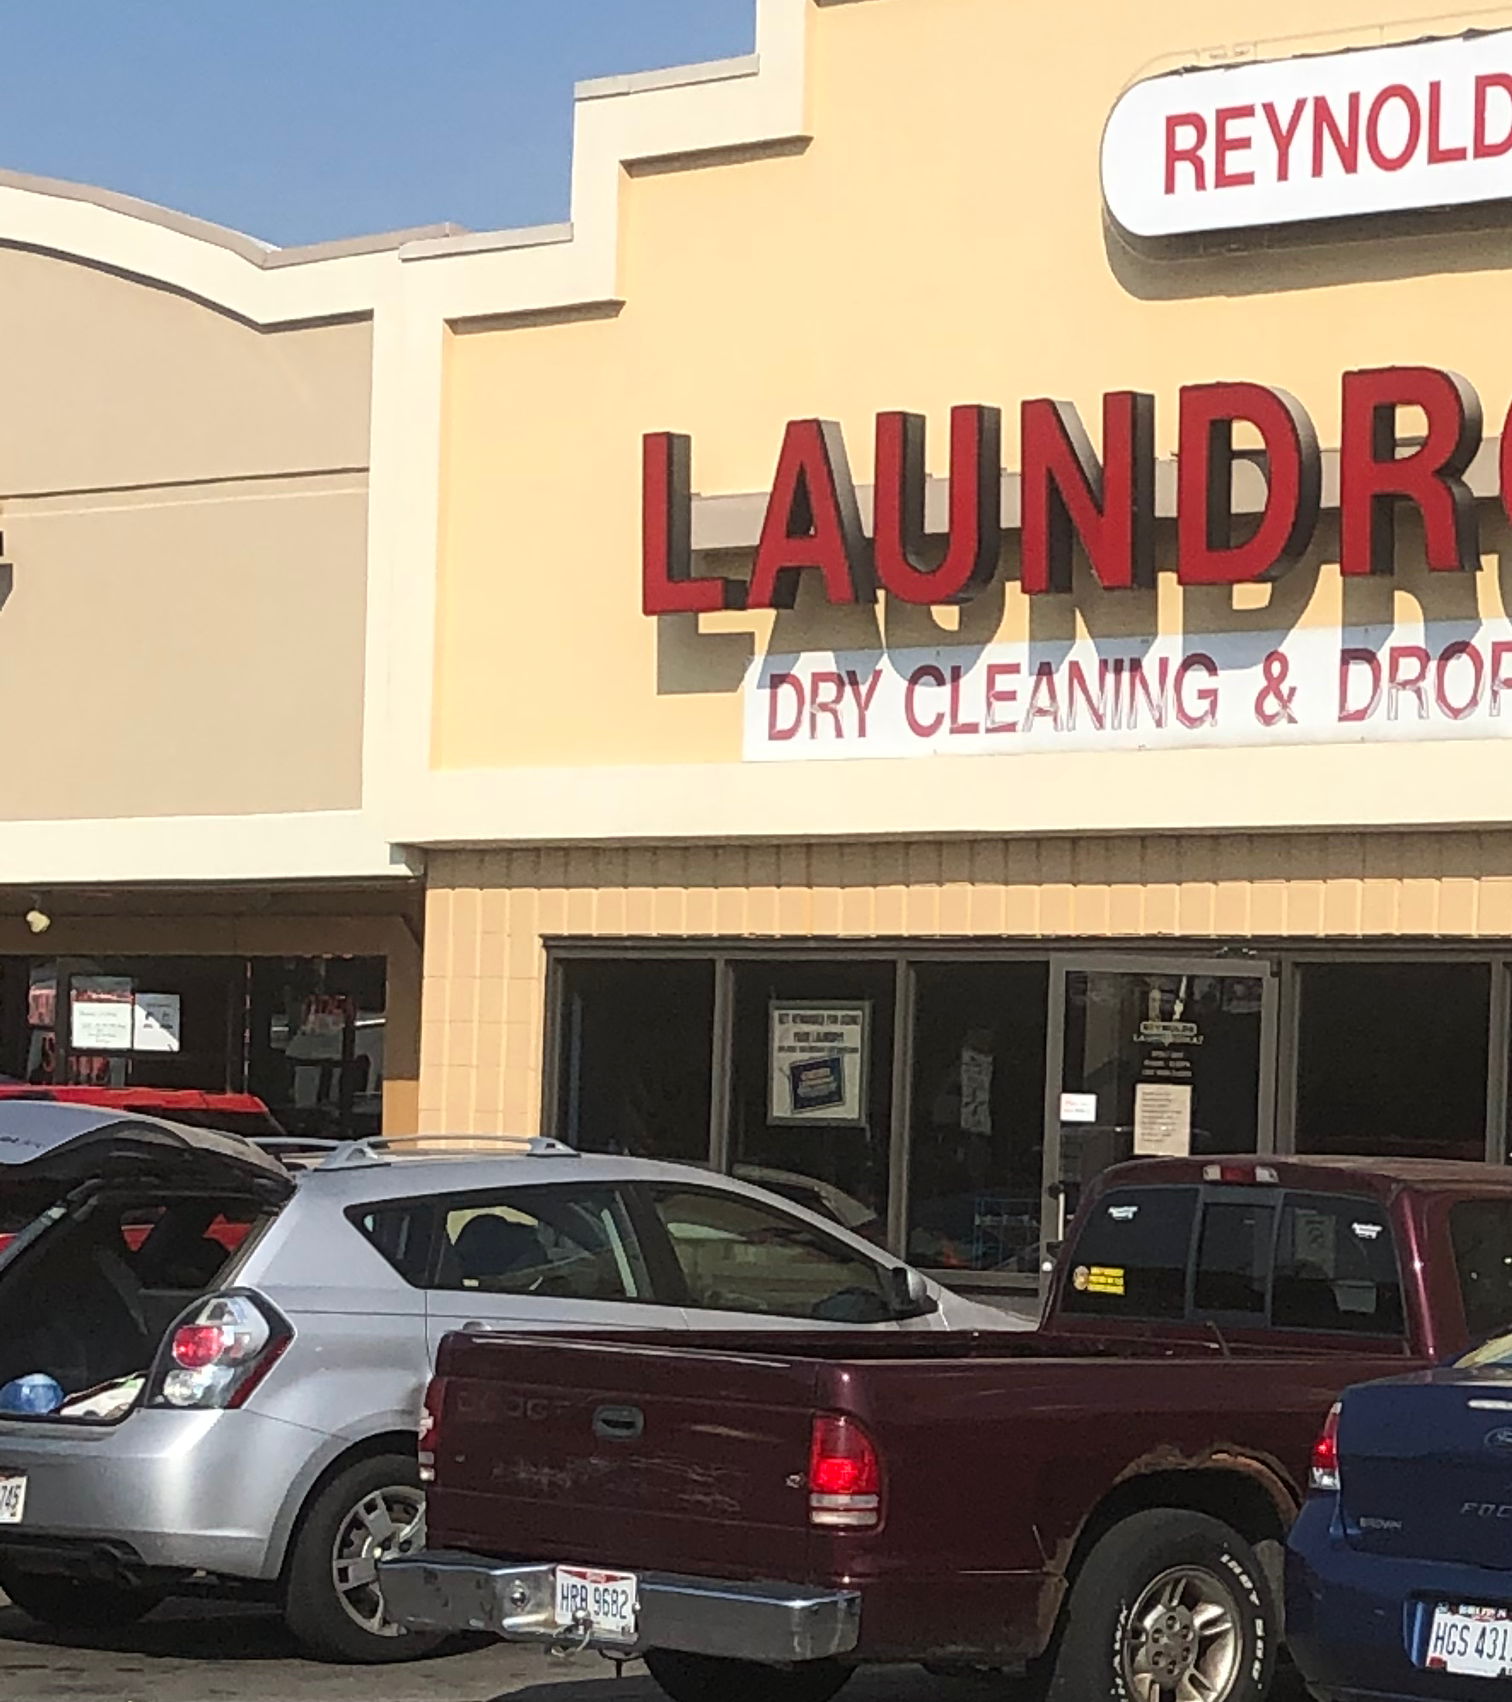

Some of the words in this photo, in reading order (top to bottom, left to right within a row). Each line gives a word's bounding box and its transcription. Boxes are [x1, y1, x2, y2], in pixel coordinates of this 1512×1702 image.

[767, 667, 883, 742] DRY
[904, 651, 1220, 737] CLEANING
[1253, 650, 1299, 726] &
[593, 1587, 629, 1619] 9682
[1433, 1621, 1471, 1657] HGS
